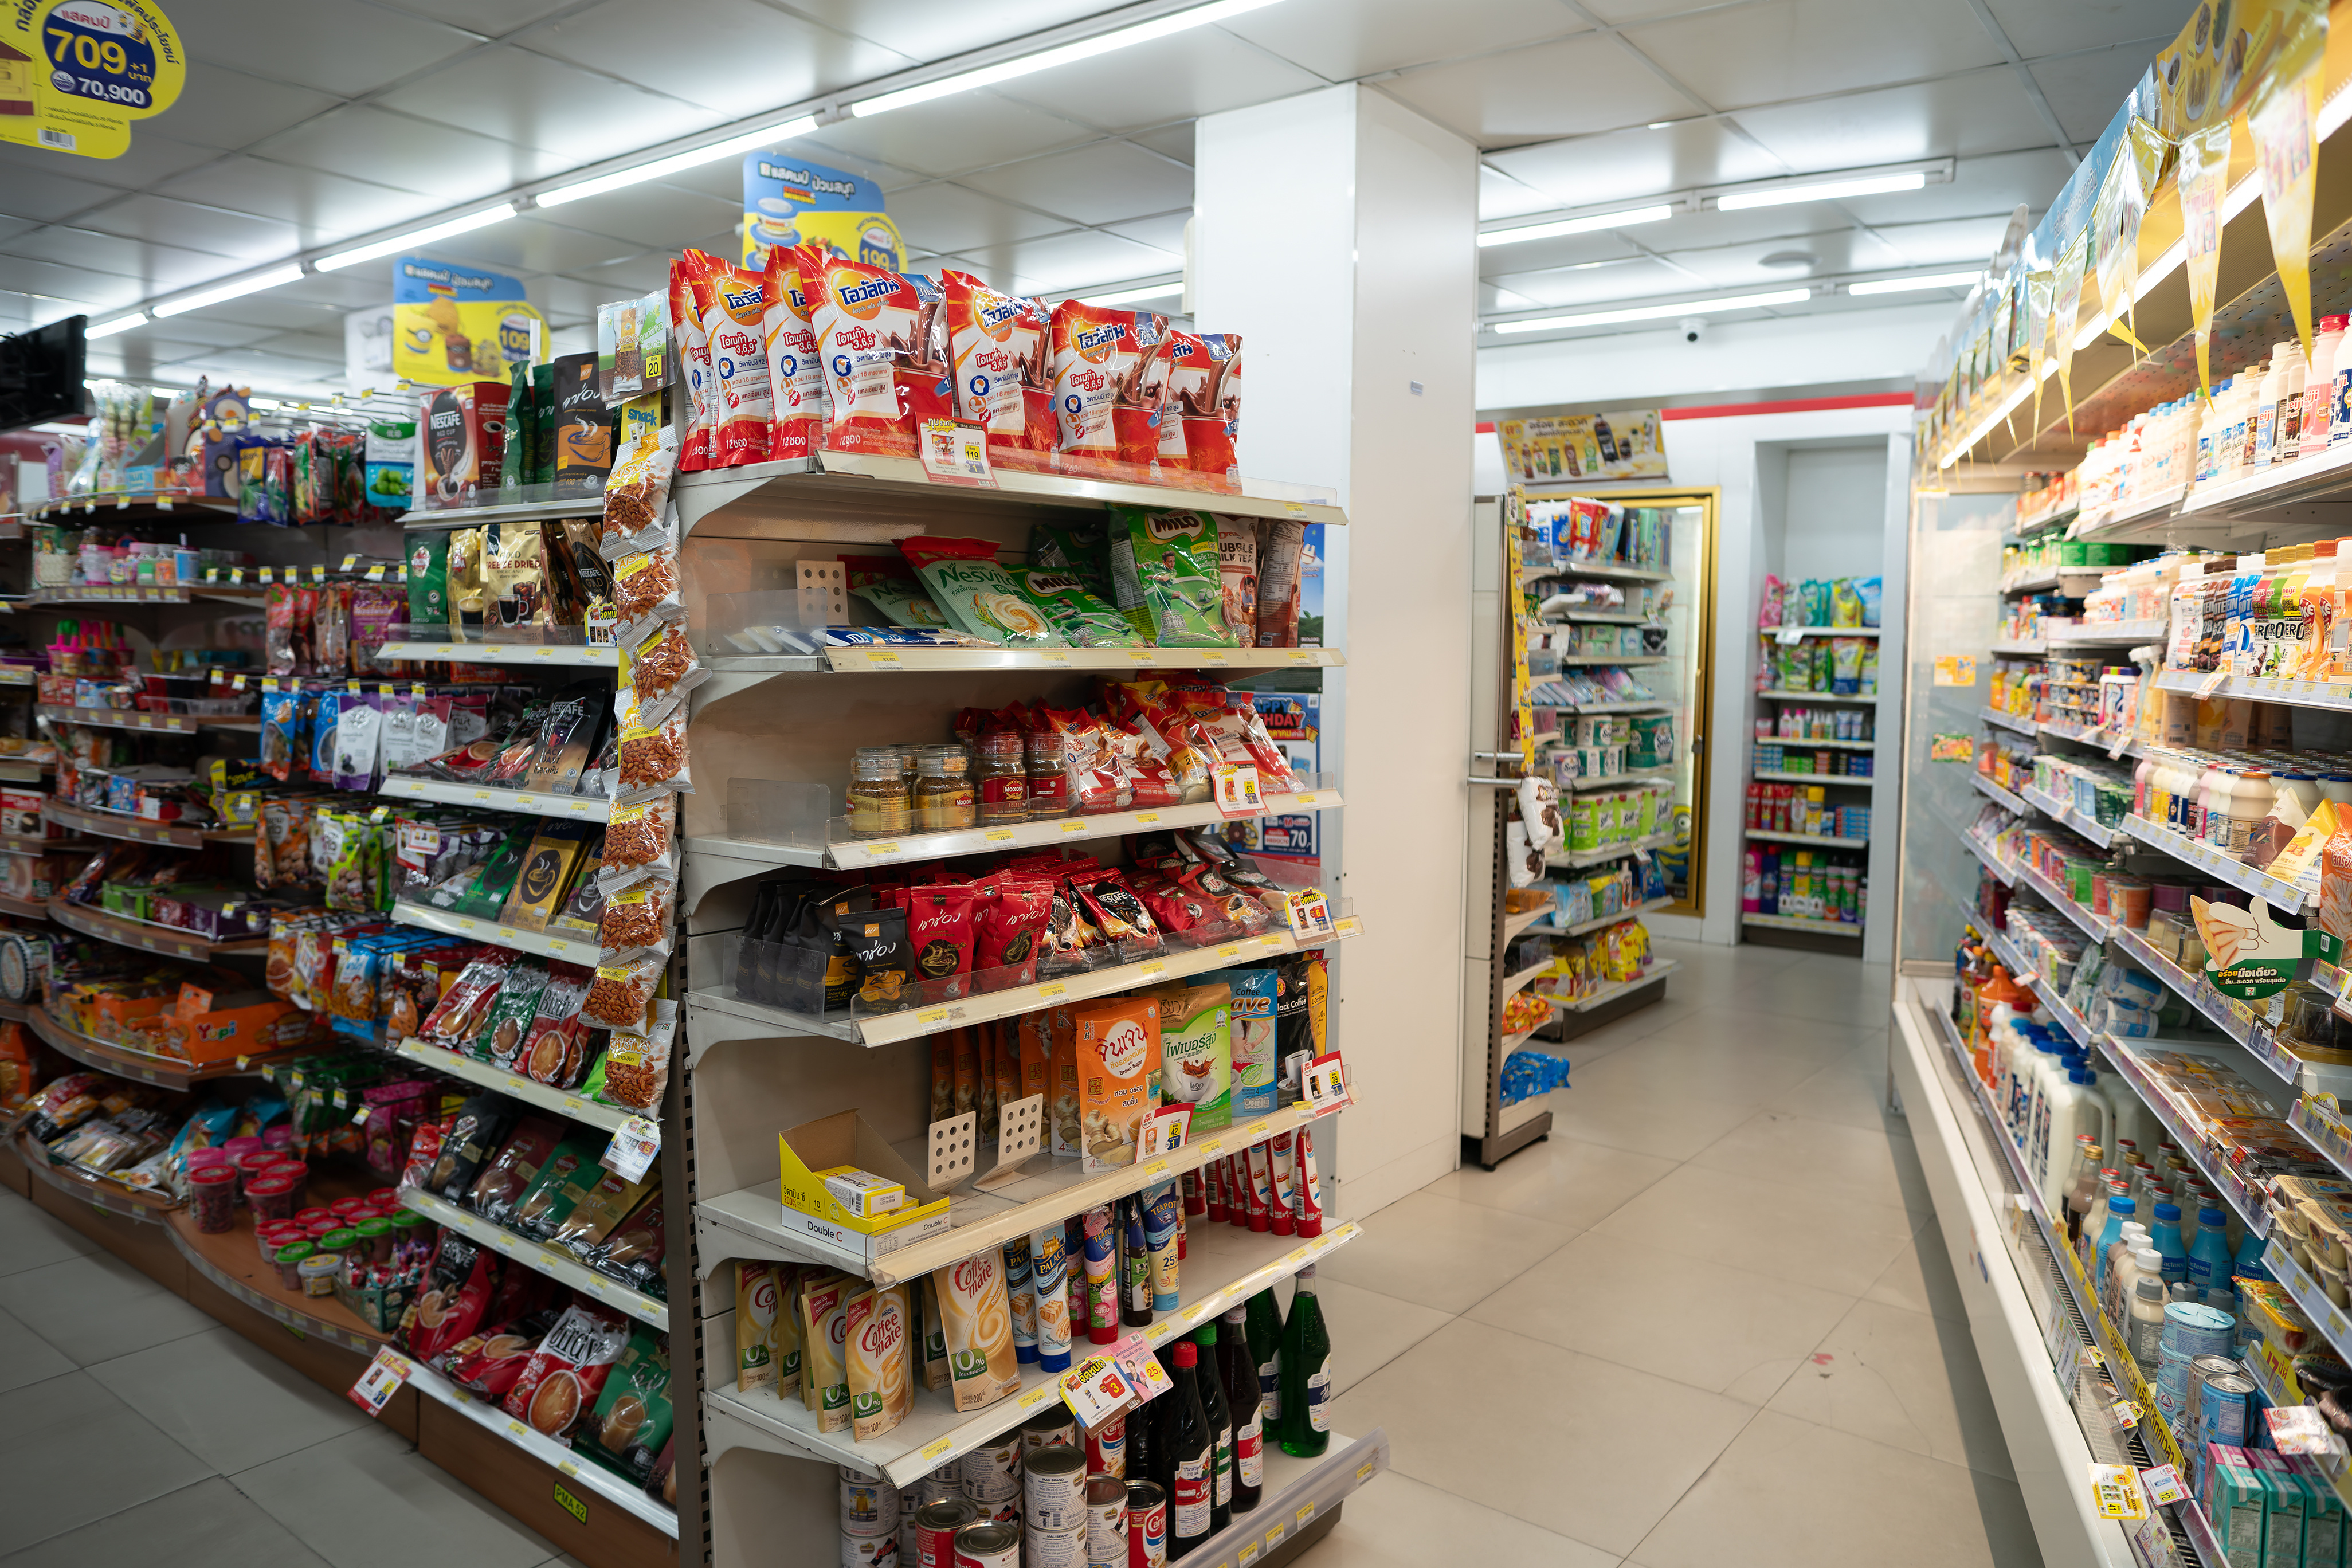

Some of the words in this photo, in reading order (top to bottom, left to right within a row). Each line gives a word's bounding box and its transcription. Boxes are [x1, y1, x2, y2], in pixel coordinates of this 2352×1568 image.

[46, 27, 127, 75] 709
[130, 62, 148, 73] +1
[128, 71, 152, 83] บาท
[77, 77, 146, 105] 70,900
[861, 248, 890, 272] 199
[838, 279, 900, 305] โอวัลติน
[721, 333, 748, 346] โอเมก้า
[837, 327, 865, 345] โอเมก้า
[1077, 323, 1126, 350] โอวัลติน
[1071, 370, 1096, 385] โอเมก้า
[858, 385, 877, 394] แคลเซียม
[993, 404, 1012, 414] แคลเซียม
[627, 407, 657, 427] snack
[966, 450, 979, 461] 119
[1152, 516, 1200, 533] MILO
[514, 560, 540, 569] DRIED
[621, 563, 642, 577] ลูกเกดเขียว
[937, 564, 1018, 589] Nesvita
[628, 730, 653, 738] ลูกเกดเขียว
[1246, 785, 1253, 793] 63
[1300, 893, 1322, 906] จัดหนัก
[917, 909, 961, 932] เขาช่อง
[1006, 905, 1046, 926] เขาช่อง
[1319, 920, 1324, 930] 7
[1291, 998, 1307, 1008] Coffee
[194, 1021, 238, 1042] Yupi
[610, 1037, 652, 1055] RAISINS
[1094, 1022, 1149, 1062] จินเจน
[1166, 1033, 1217, 1058] ไฟเบอร์สูง
[1110, 1045, 1146, 1069] ขิงรสยอดนิยม
[1119, 1065, 1132, 1076] Brown
[1132, 1060, 1143, 1070] Sugar
[1248, 1069, 1260, 1083] Natural
[1332, 1075, 1338, 1083] 39
[1114, 1088, 1127, 1097] หอม
[1130, 1084, 1143, 1094] อร่อย
[1122, 1098, 1138, 1107] สดชื่น
[1171, 1127, 1178, 1136] 42
[1089, 1159, 1096, 1169] 4
[836, 1175, 868, 1188] Double
[783, 1185, 800, 1199] วิตามิน
[801, 1191, 805, 1202] ซี
[784, 1194, 797, 1208] 200%
[813, 1199, 821, 1208] 10
[1150, 1201, 1177, 1216] TEAPOT
[807, 1220, 835, 1238] Double
[836, 1231, 843, 1242] C
[923, 1219, 942, 1230] Double
[1092, 1226, 1114, 1244] TEAPOT
[1040, 1246, 1065, 1274] PALACE
[2188, 1256, 2210, 1273] Lactasoy
[2236, 1264, 2262, 1279] Lactasoy
[969, 1263, 993, 1299] mate
[814, 1299, 822, 1307] หอม
[815, 1300, 833, 1314] กลมกล่อม
[1094, 1304, 1110, 1314] นมเย็น
[861, 1313, 898, 1351] Coffee
[1158, 1327, 1167, 1335] 25.00
[875, 1324, 901, 1359] mate
[756, 1373, 766, 1382] 100
[1079, 1359, 1106, 1383] จัดหนัก
[1147, 1366, 1162, 1378] 25.-
[2121, 1357, 2139, 1386] สะดวก
[1110, 1383, 1119, 1393] 3
[974, 1393, 982, 1403] 200
[1032, 1394, 1044, 1403] 41.00
[840, 1414, 848, 1424] 100
[870, 1422, 879, 1433] 100
[936, 1445, 950, 1455] 27.00
[554, 1486, 574, 1511] PMA
[572, 1500, 586, 1520] 52
[2160, 1492, 2171, 1500] 12
[994, 1501, 1016, 1523] Mali
